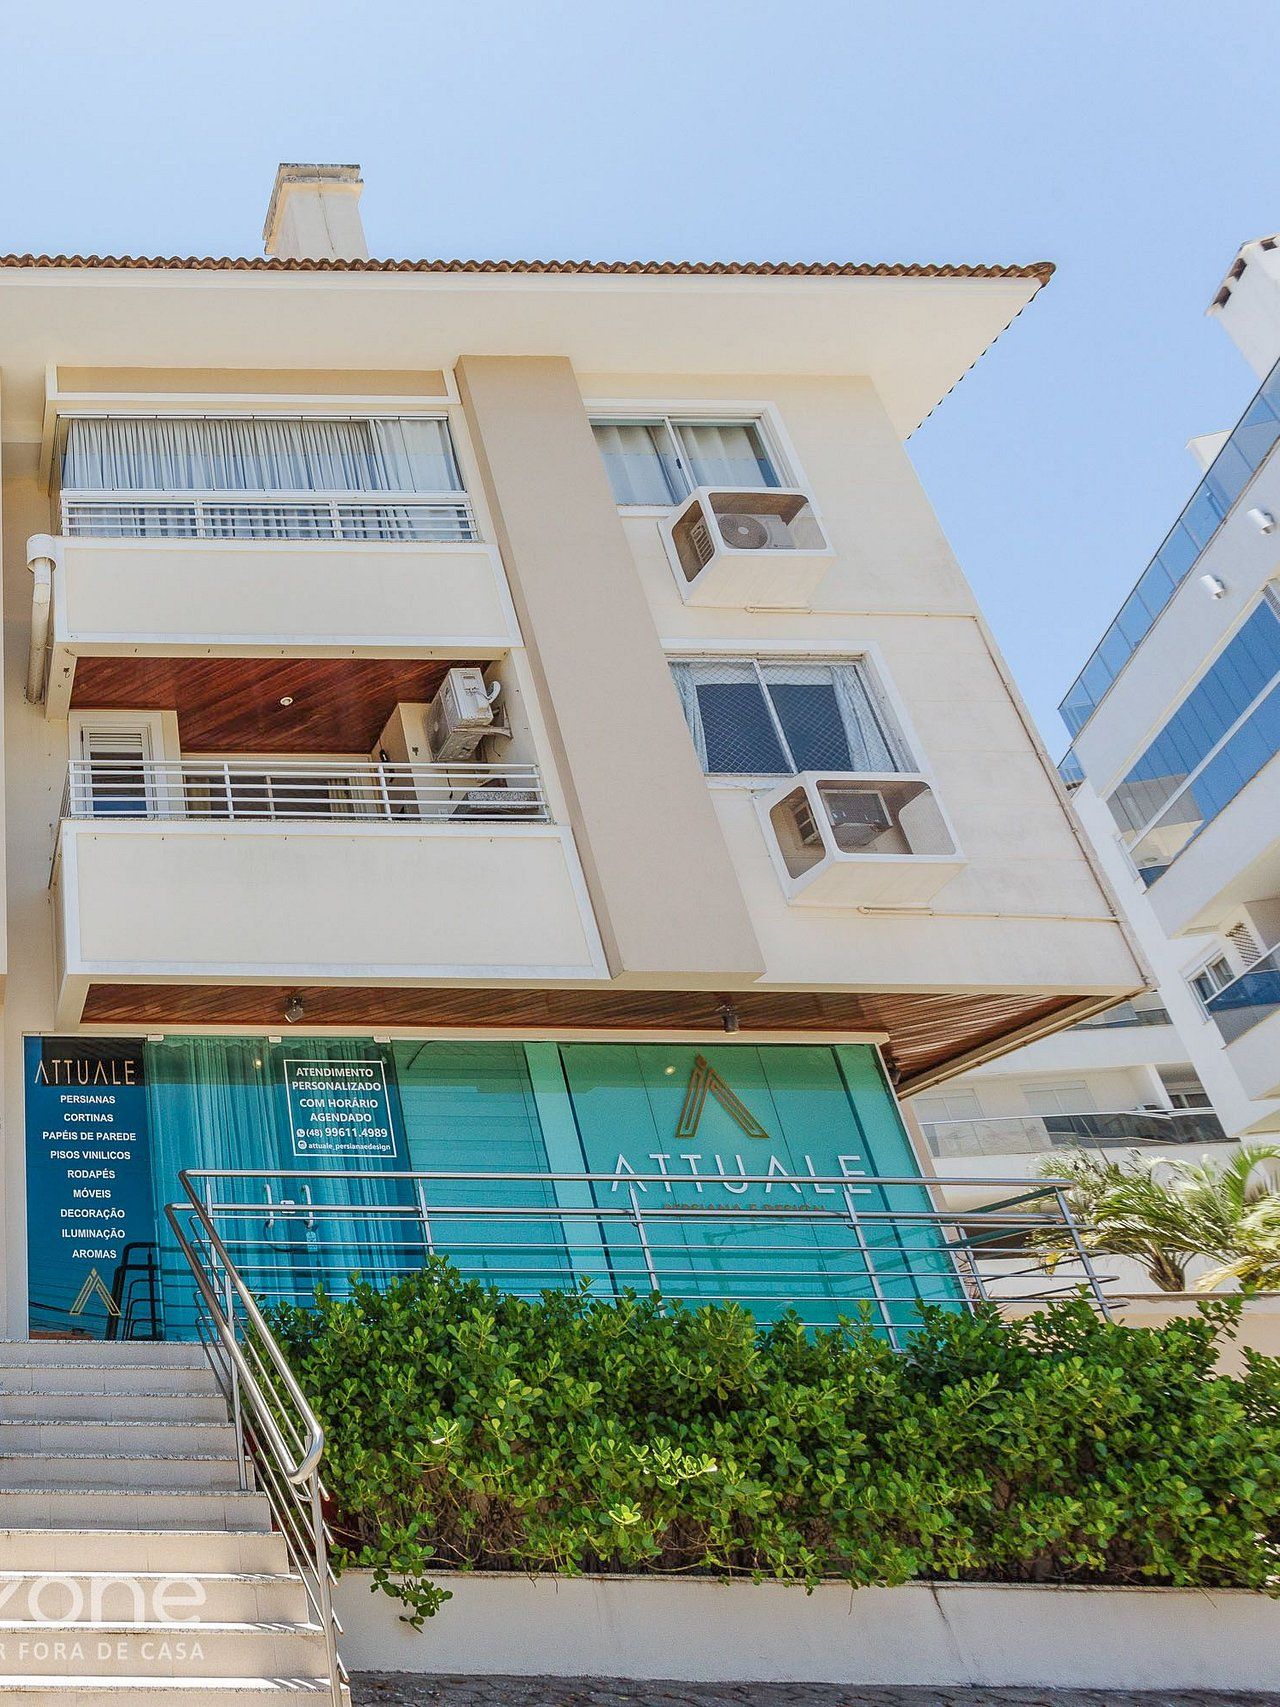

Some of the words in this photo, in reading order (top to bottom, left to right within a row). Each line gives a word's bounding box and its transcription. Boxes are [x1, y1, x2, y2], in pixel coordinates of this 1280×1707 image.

[34, 1060, 136, 1085] ATTUALE
[296, 1067, 374, 1077] ATENDIMENTO
[292, 1081, 381, 1091] PERSONALIZADO
[60, 1095, 116, 1104] PERSIANAS
[300, 1098, 325, 1108] COM
[328, 1097, 379, 1108] HORÁRIO
[63, 1113, 114, 1122] CORTINAS
[310, 1113, 372, 1122] AGENDADO
[42, 1130, 78, 1140] PAPÉIS
[80, 1132, 94, 1140] DE
[96, 1132, 137, 1141] PAREDE
[306, 1128, 323, 1138] (48)
[325, 1127, 388, 1138] 99611.4989
[50, 1150, 80, 1159] PISOS
[82, 1150, 131, 1160] VINILICOS
[67, 1168, 116, 1179] RODAPÉS
[611, 1153, 872, 1194] ATTUALE
[73, 1187, 111, 1198] MÓVEIS
[60, 1208, 125, 1220] DECORAÇÃO
[61, 1228, 126, 1240] ILUMINAÇÃO
[72, 1249, 117, 1259] AROMAS
